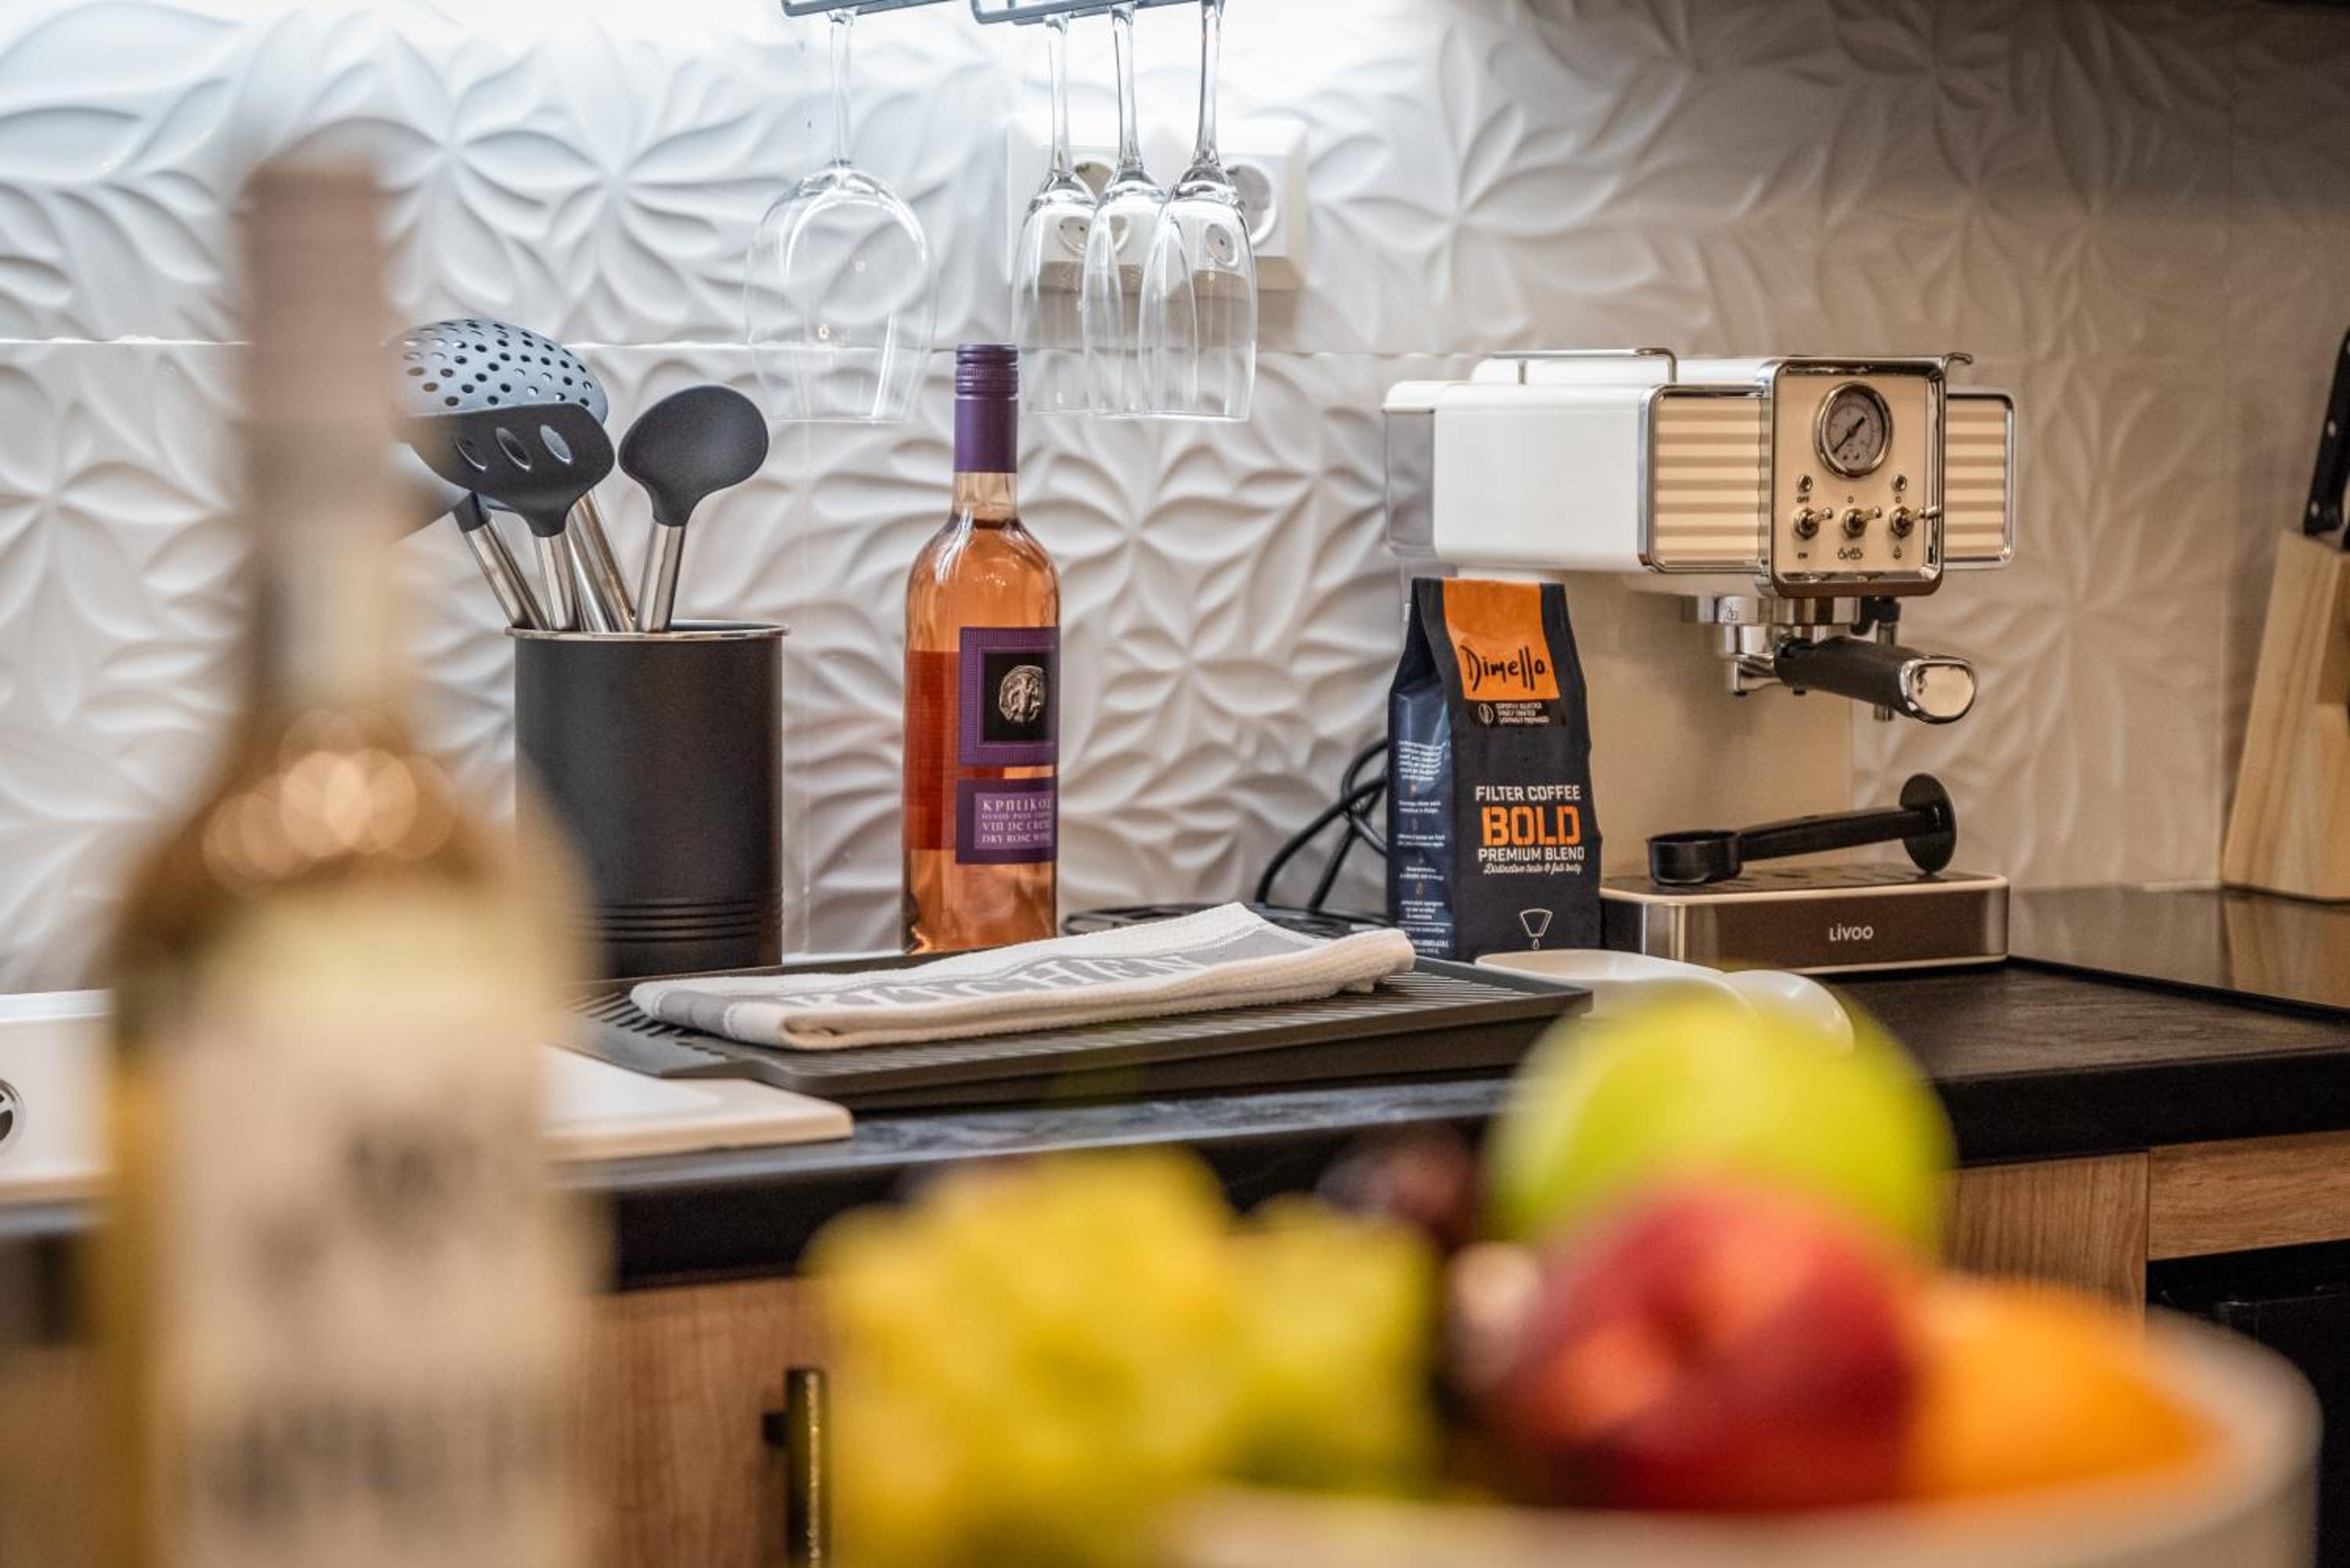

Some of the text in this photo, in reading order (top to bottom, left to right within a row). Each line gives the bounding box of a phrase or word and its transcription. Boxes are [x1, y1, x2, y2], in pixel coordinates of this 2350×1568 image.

[1460, 644, 1546, 691] Dimello
[1476, 786, 1581, 801] FILTER COFFEE
[1480, 805, 1582, 846] BOLD
[1478, 846, 1585, 862] PREMIUM BLEND
